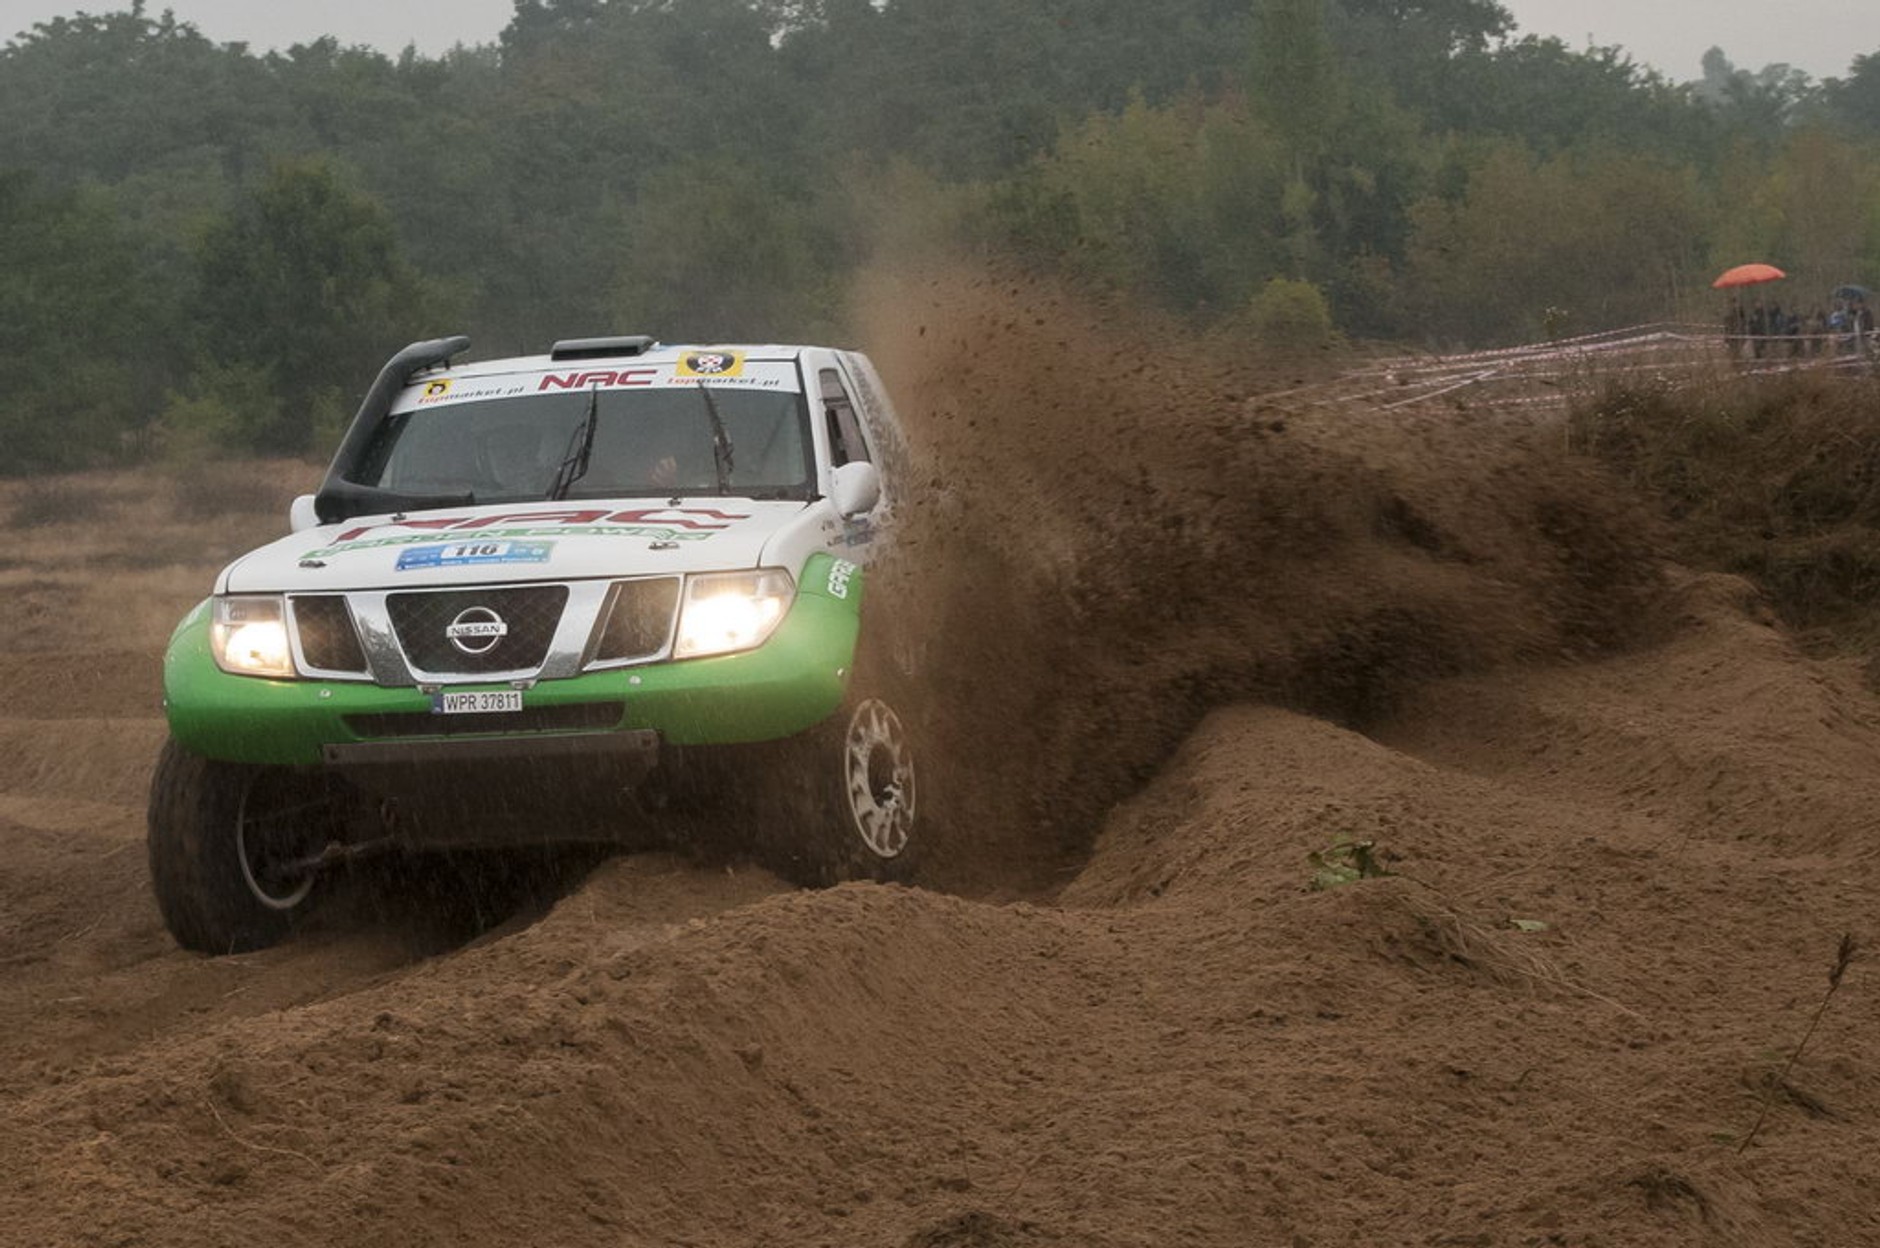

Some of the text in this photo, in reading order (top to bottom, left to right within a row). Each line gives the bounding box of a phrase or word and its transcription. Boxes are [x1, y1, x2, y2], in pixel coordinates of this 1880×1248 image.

[538, 369, 657, 391] NAC
[451, 625, 500, 635] NISSAN
[446, 693, 519, 710] WPR 37811
